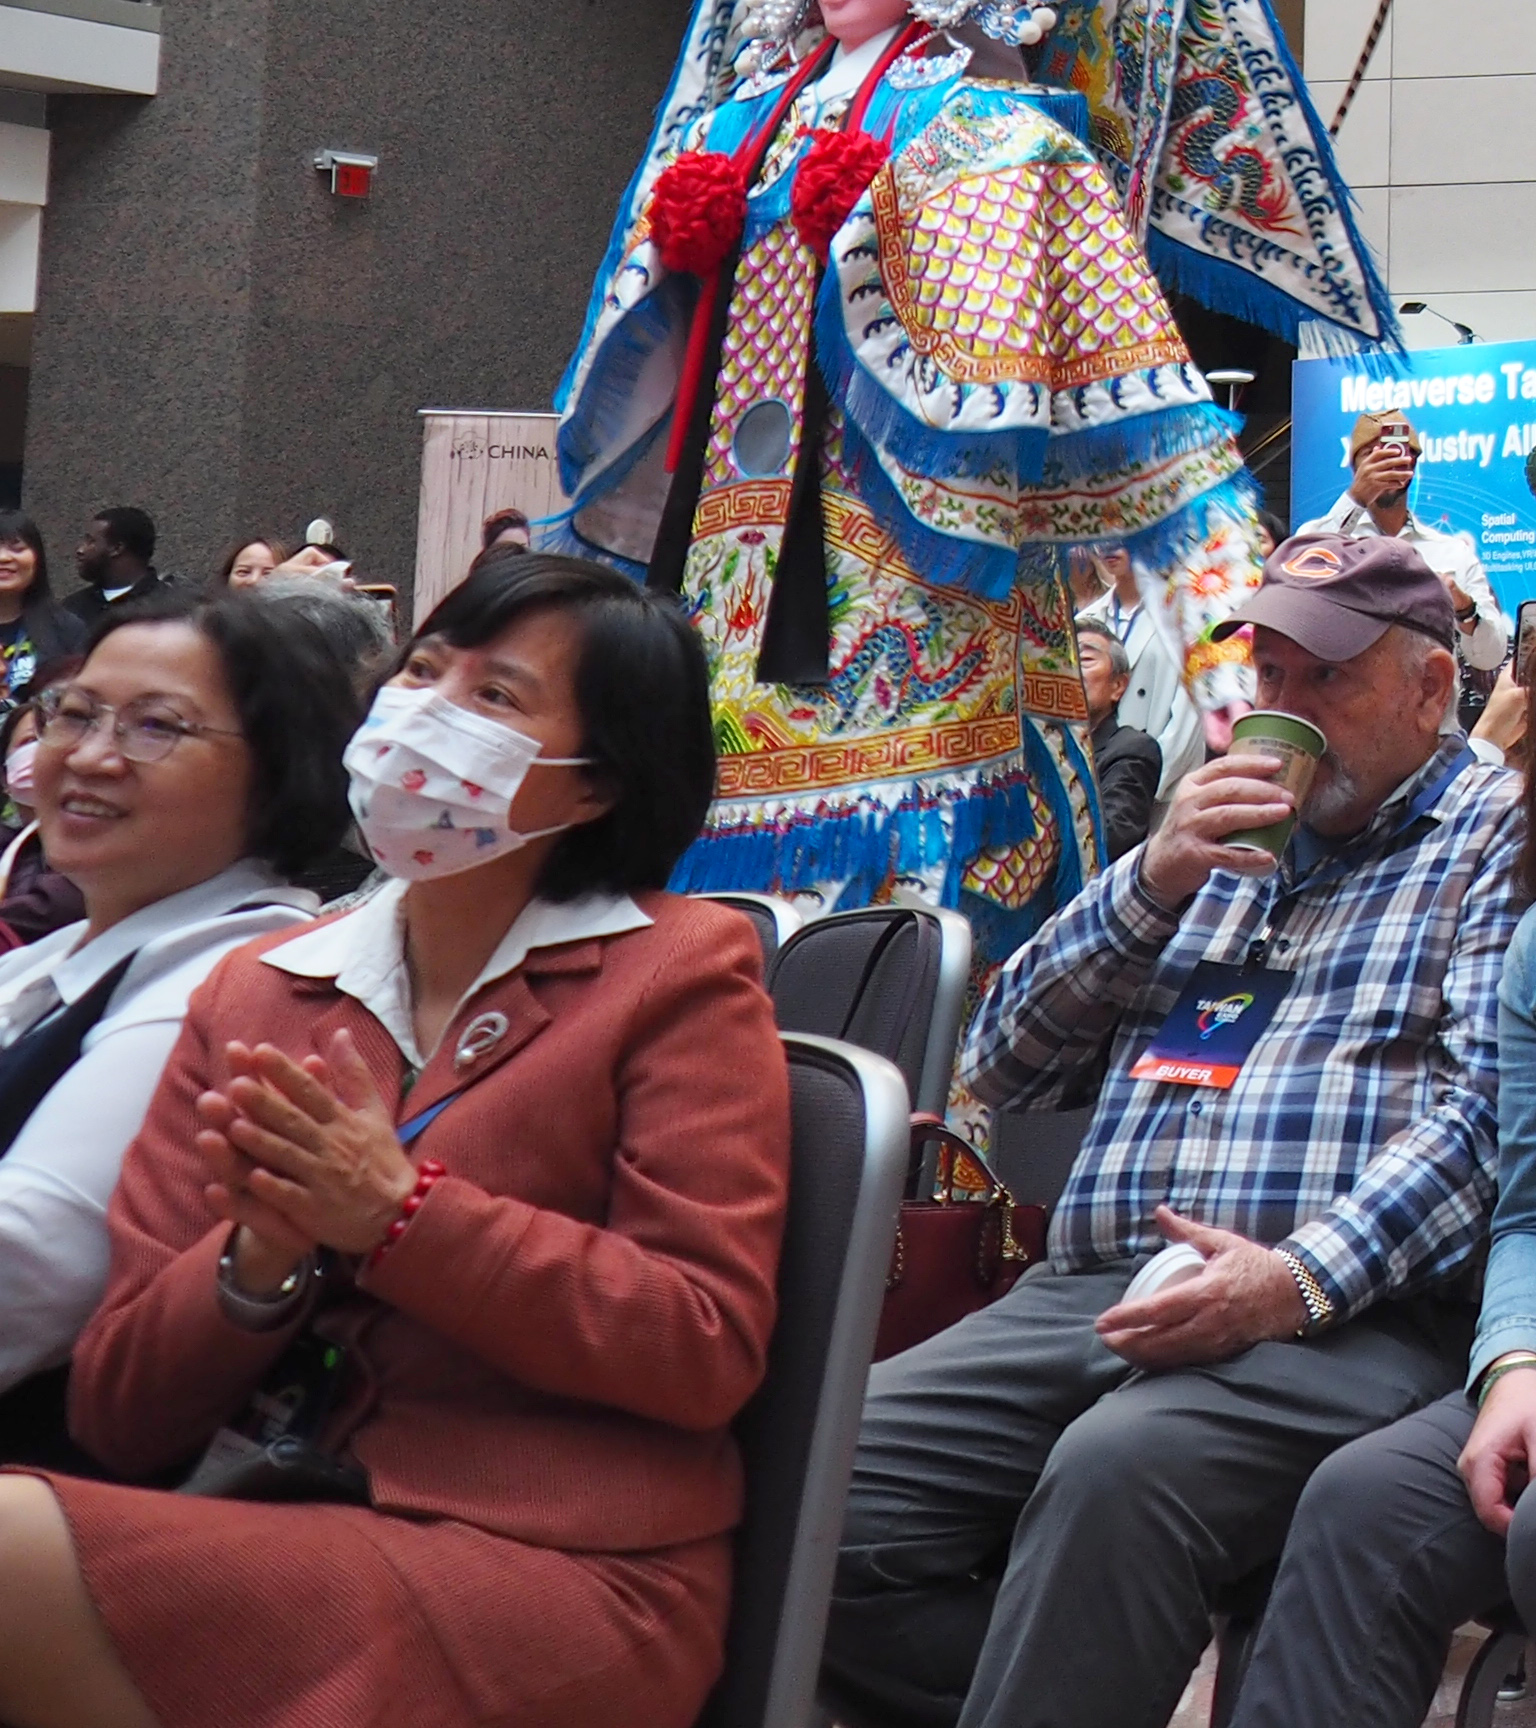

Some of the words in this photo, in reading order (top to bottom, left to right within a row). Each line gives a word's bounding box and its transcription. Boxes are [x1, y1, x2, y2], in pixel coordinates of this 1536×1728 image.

[1340, 372, 1495, 412] Metaverse
[488, 445, 549, 460] CHINA
[1481, 512, 1516, 528] Spatial
[1481, 529, 1536, 545] Computing
[1196, 999, 1244, 1016] TAIWAN
[1155, 1065, 1213, 1080] BUYER
